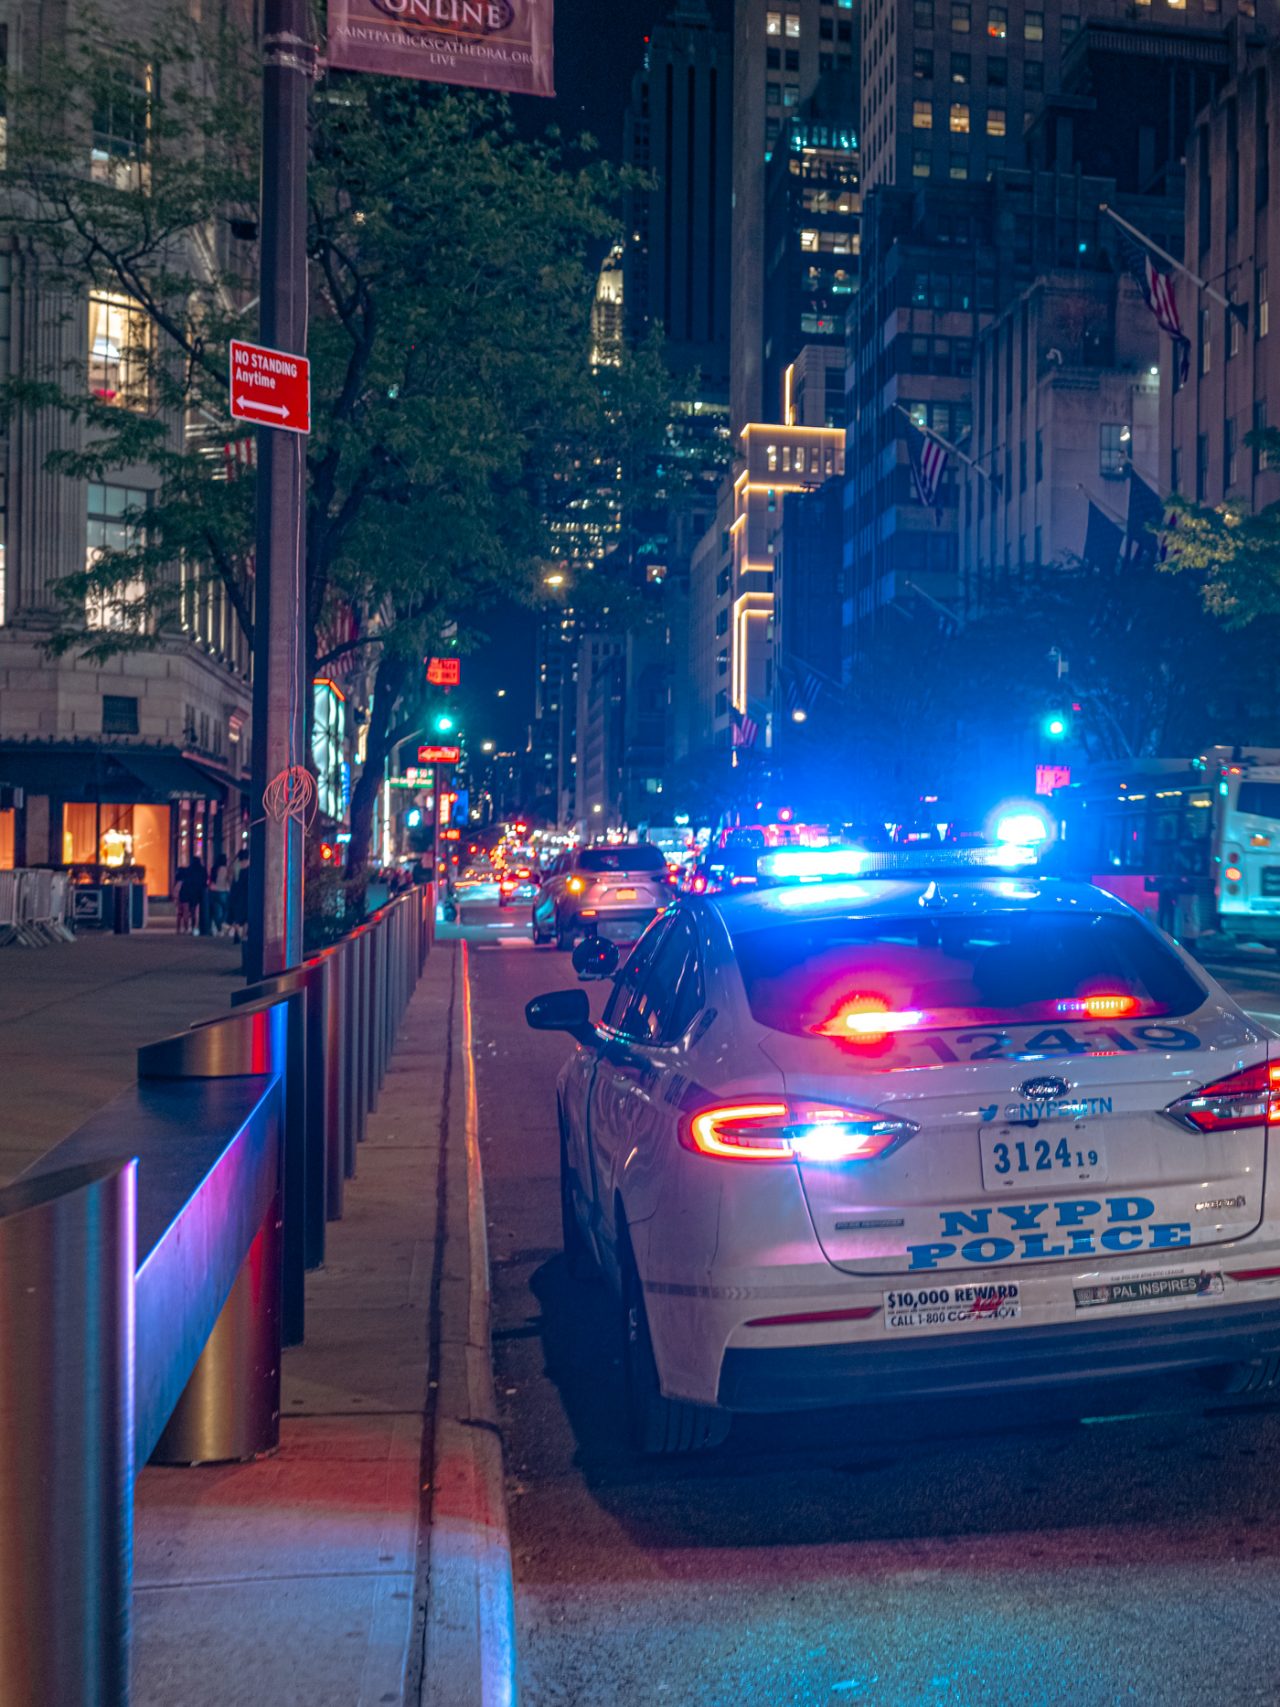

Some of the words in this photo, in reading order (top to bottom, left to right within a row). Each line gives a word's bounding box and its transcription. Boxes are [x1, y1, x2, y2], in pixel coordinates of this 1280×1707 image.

[385, 0, 501, 29] ONLINE
[430, 53, 456, 67] LIVE
[235, 349, 249, 366] NO
[251, 353, 298, 378] STANDING
[236, 366, 276, 390] Anytime
[939, 1196, 1155, 1237] NYPD
[906, 1222, 1192, 1270] POLICE
[888, 1289, 950, 1309] $10,000
[954, 1284, 1018, 1303] REWARD
[1113, 1285, 1137, 1299] PAL
[1139, 1277, 1198, 1297] INSPIRES
[890, 1314, 915, 1327] CALL
[918, 1311, 945, 1325] 1-800
